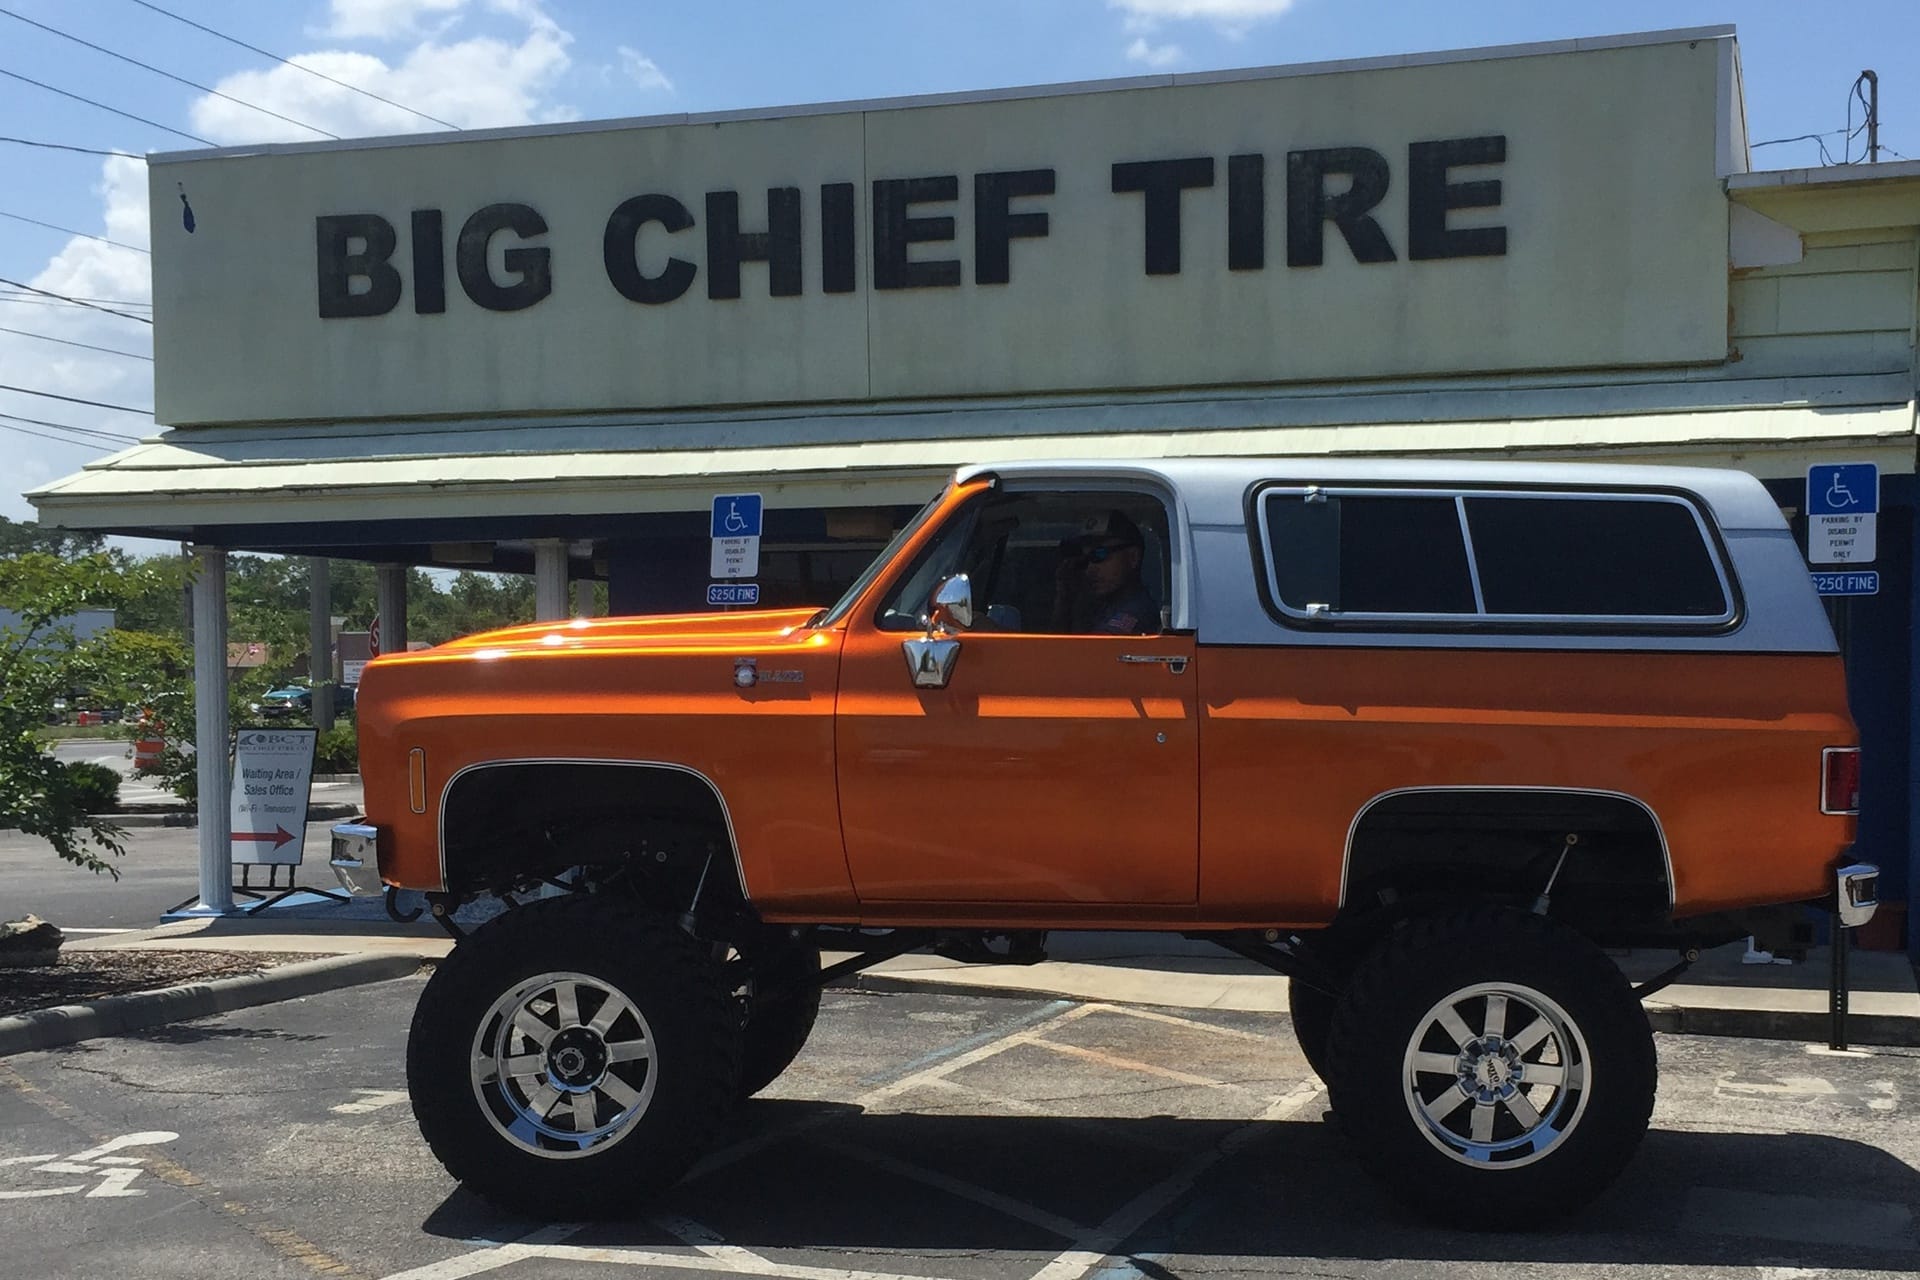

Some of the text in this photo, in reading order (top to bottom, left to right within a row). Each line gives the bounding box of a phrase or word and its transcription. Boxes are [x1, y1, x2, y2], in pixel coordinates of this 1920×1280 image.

[315, 135, 1507, 319] BIG CHIEF TIRE
[1822, 516, 1849, 524] PARKING
[1827, 527, 1857, 536] DISABLED
[1830, 539, 1855, 547] PERMIT
[1833, 551, 1851, 559] ONLY
[1847, 576, 1876, 590] FINE
[710, 587, 757, 601] $250 FINE
[242, 767, 274, 781] Waiting
[275, 768, 295, 780] Area
[244, 784, 295, 796] Sales Office
